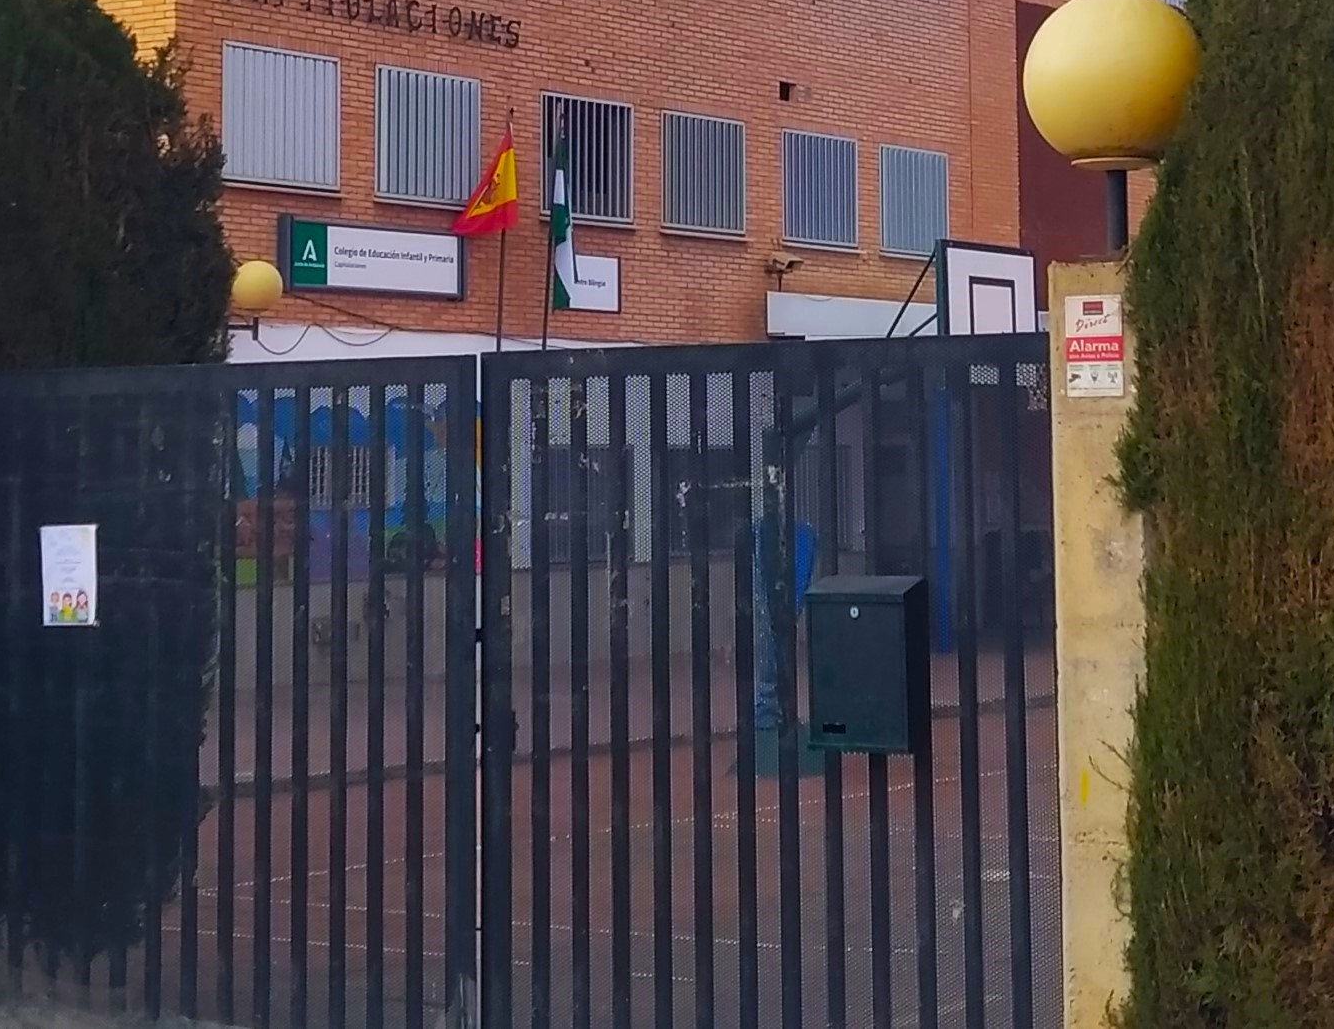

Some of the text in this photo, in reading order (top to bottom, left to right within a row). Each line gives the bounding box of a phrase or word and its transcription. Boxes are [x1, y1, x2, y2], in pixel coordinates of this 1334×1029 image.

[334, 246, 358, 259] Colegio
[359, 248, 367, 257] de
[368, 249, 400, 260] Educación
[401, 251, 423, 261] Infantil
[428, 254, 454, 264] Primaria
[1075, 314, 1111, 332] Direct
[1069, 339, 1119, 352] Alarma
